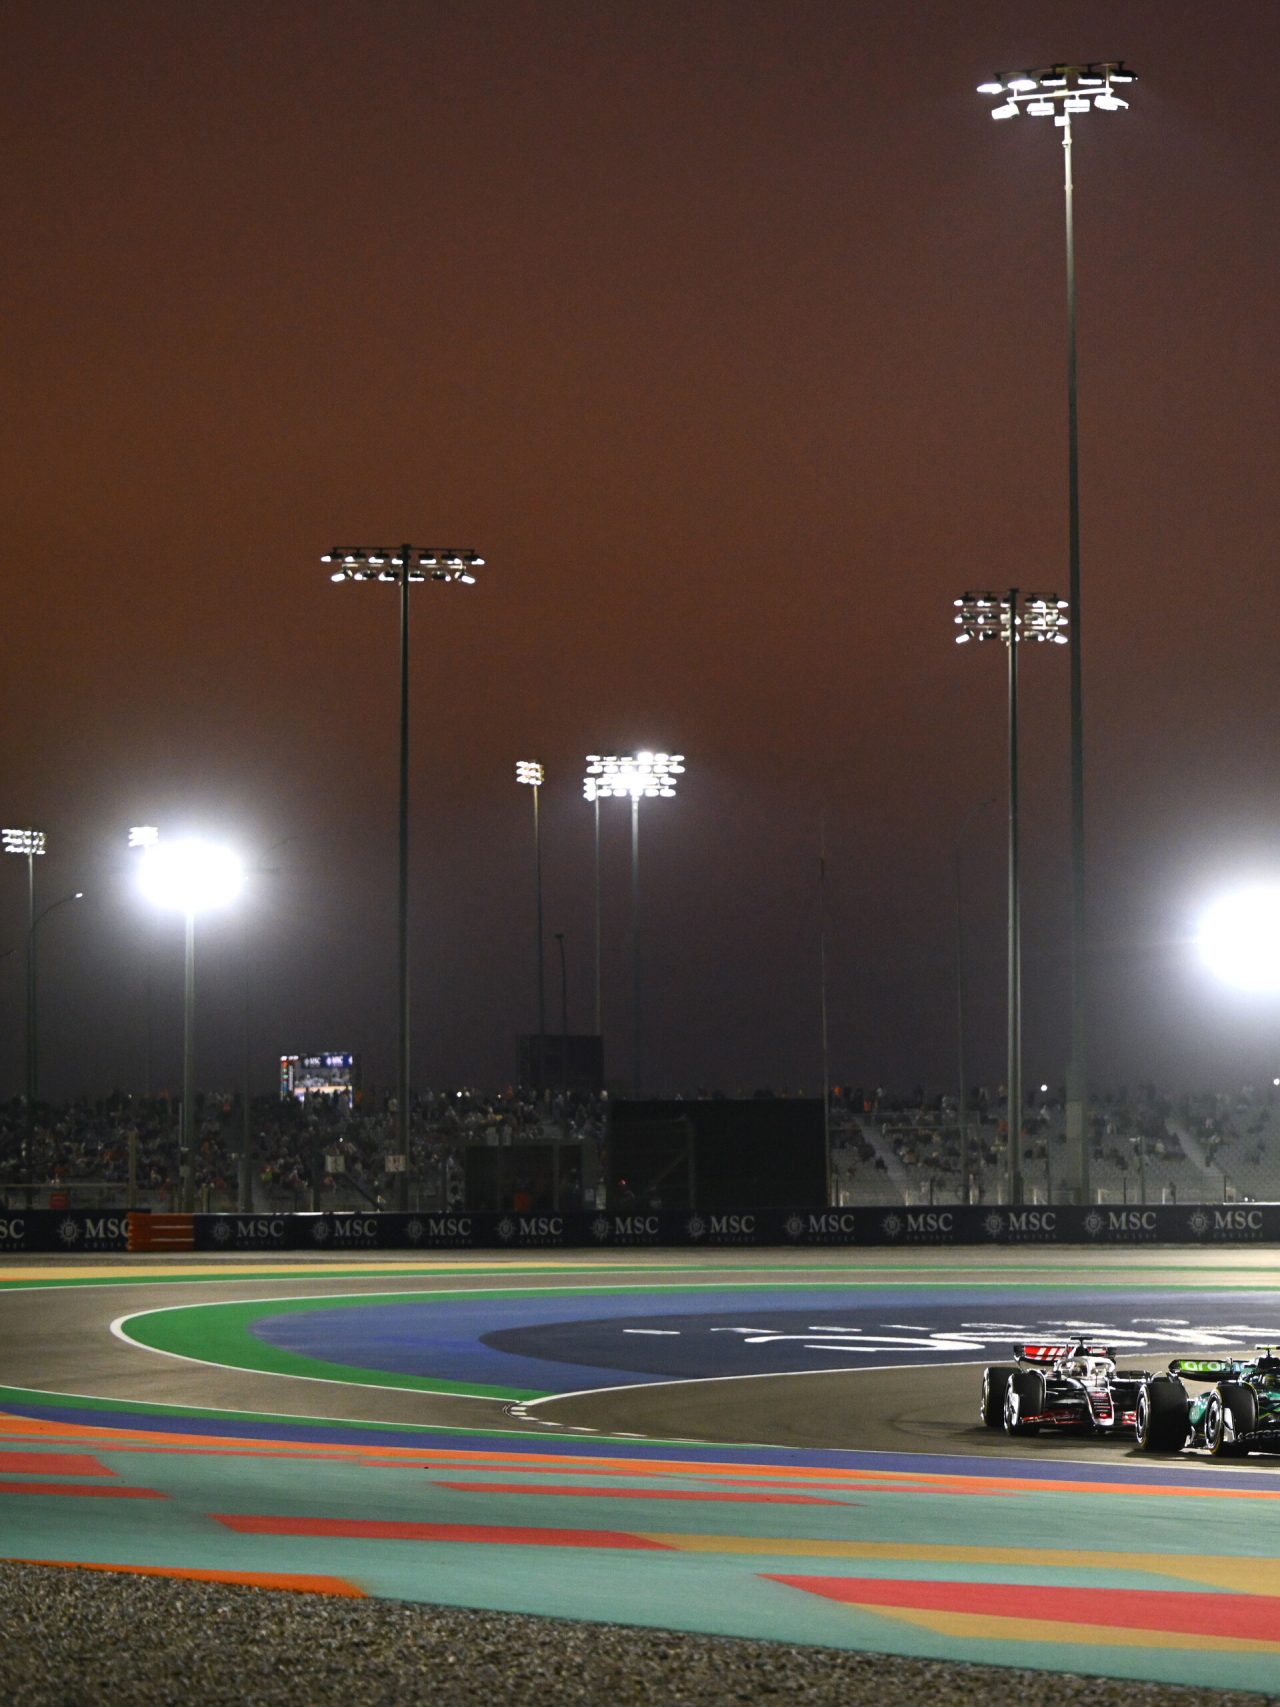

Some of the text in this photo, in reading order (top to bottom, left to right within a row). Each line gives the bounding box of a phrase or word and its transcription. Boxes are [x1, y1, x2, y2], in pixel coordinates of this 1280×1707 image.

[236, 1219, 286, 1238] MSC
[333, 1219, 378, 1237] MSC
[428, 1218, 472, 1236] MSC
[519, 1217, 564, 1235] MSC
[614, 1215, 660, 1234] MSC
[710, 1215, 755, 1233] MSC
[808, 1214, 856, 1233] MSC
[906, 1213, 953, 1231] MSC
[1008, 1212, 1057, 1230] MSC
[1108, 1211, 1158, 1230] MSC
[1212, 1210, 1263, 1229] MSC
